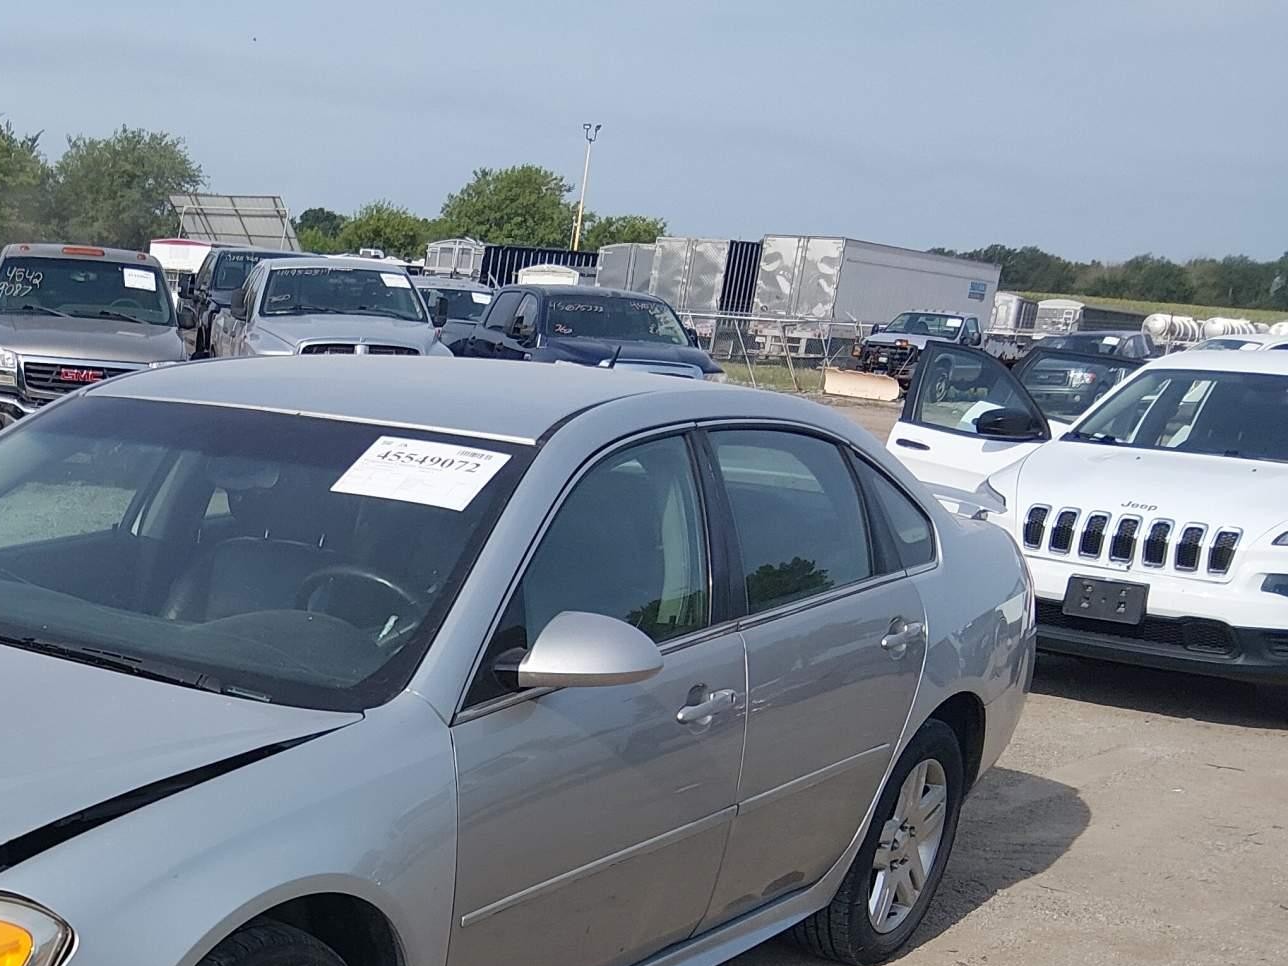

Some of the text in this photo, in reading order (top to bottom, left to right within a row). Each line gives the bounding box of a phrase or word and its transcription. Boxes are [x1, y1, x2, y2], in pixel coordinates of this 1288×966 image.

[61, 368, 104, 381] GMC
[377, 449, 481, 474] 45549072
[1120, 500, 1158, 512] Jeep
